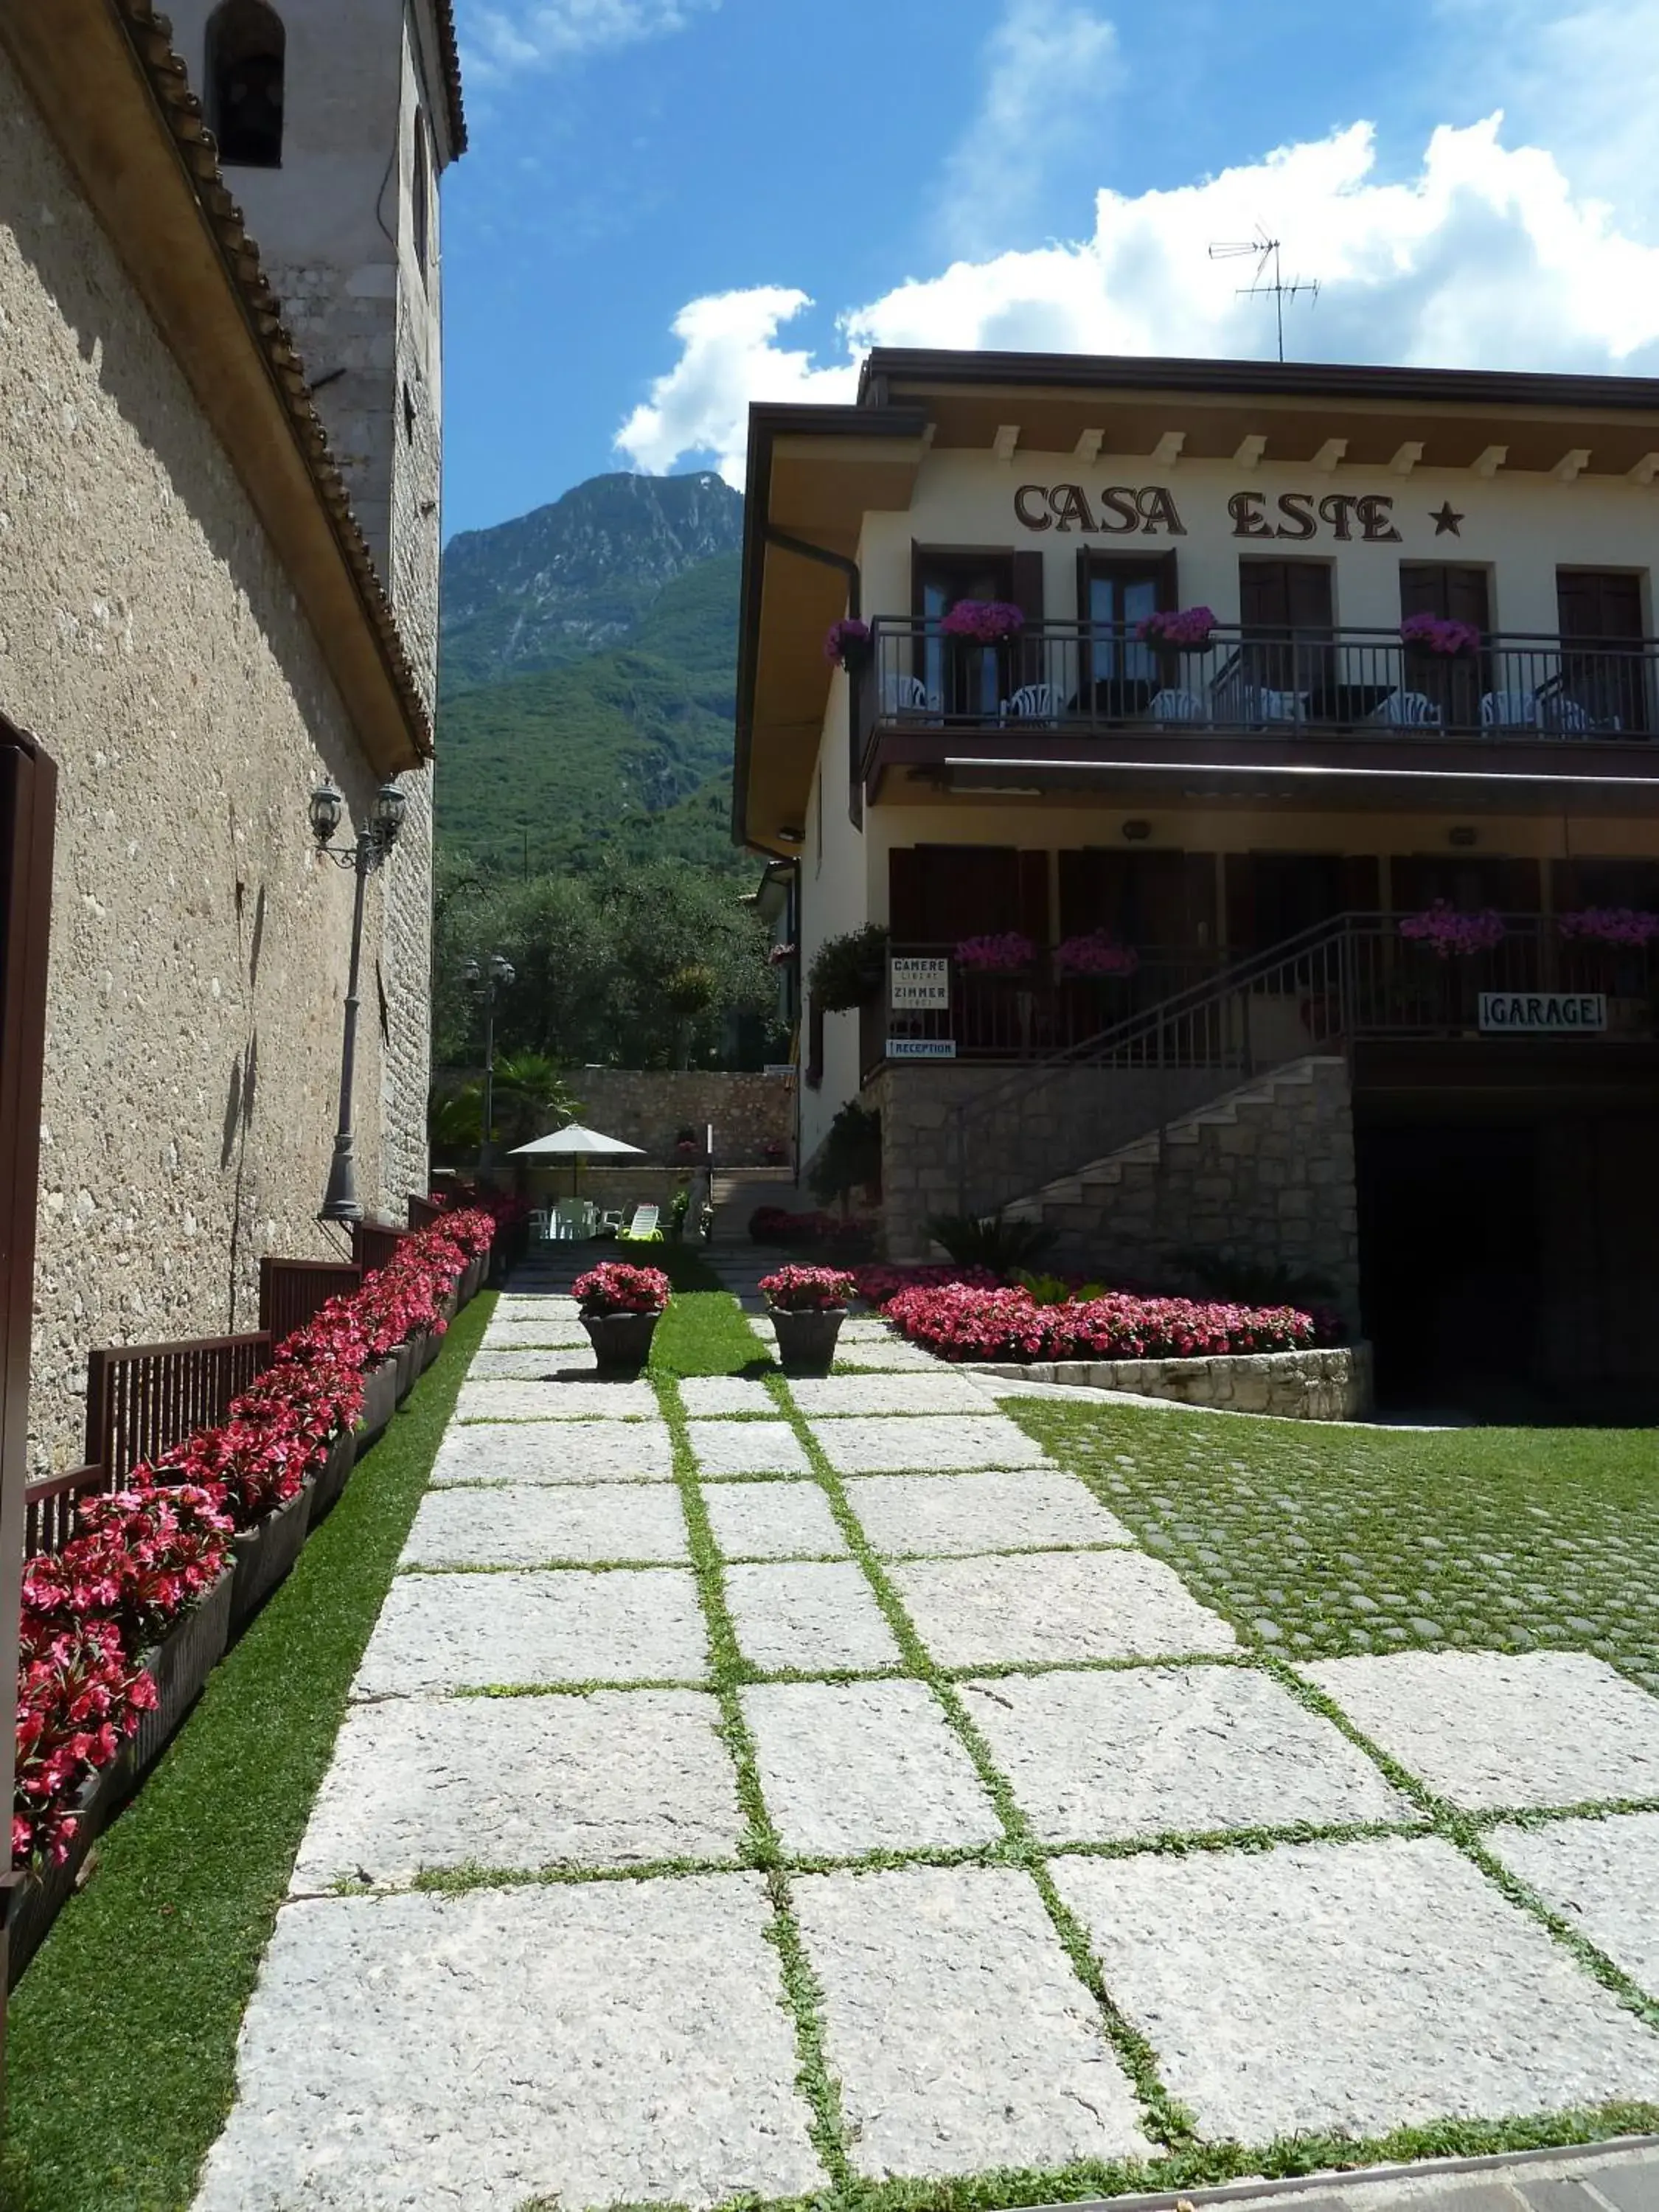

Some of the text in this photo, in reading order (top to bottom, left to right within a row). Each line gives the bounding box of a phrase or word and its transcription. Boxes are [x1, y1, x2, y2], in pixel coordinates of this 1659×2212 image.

[1014, 483, 1403, 542] CASA ESTE
[894, 961, 945, 971] CAMERE
[894, 987, 945, 998] ZIMMER
[1491, 998, 1597, 1026] GARAGE
[895, 1043, 951, 1053] RECEPTION
